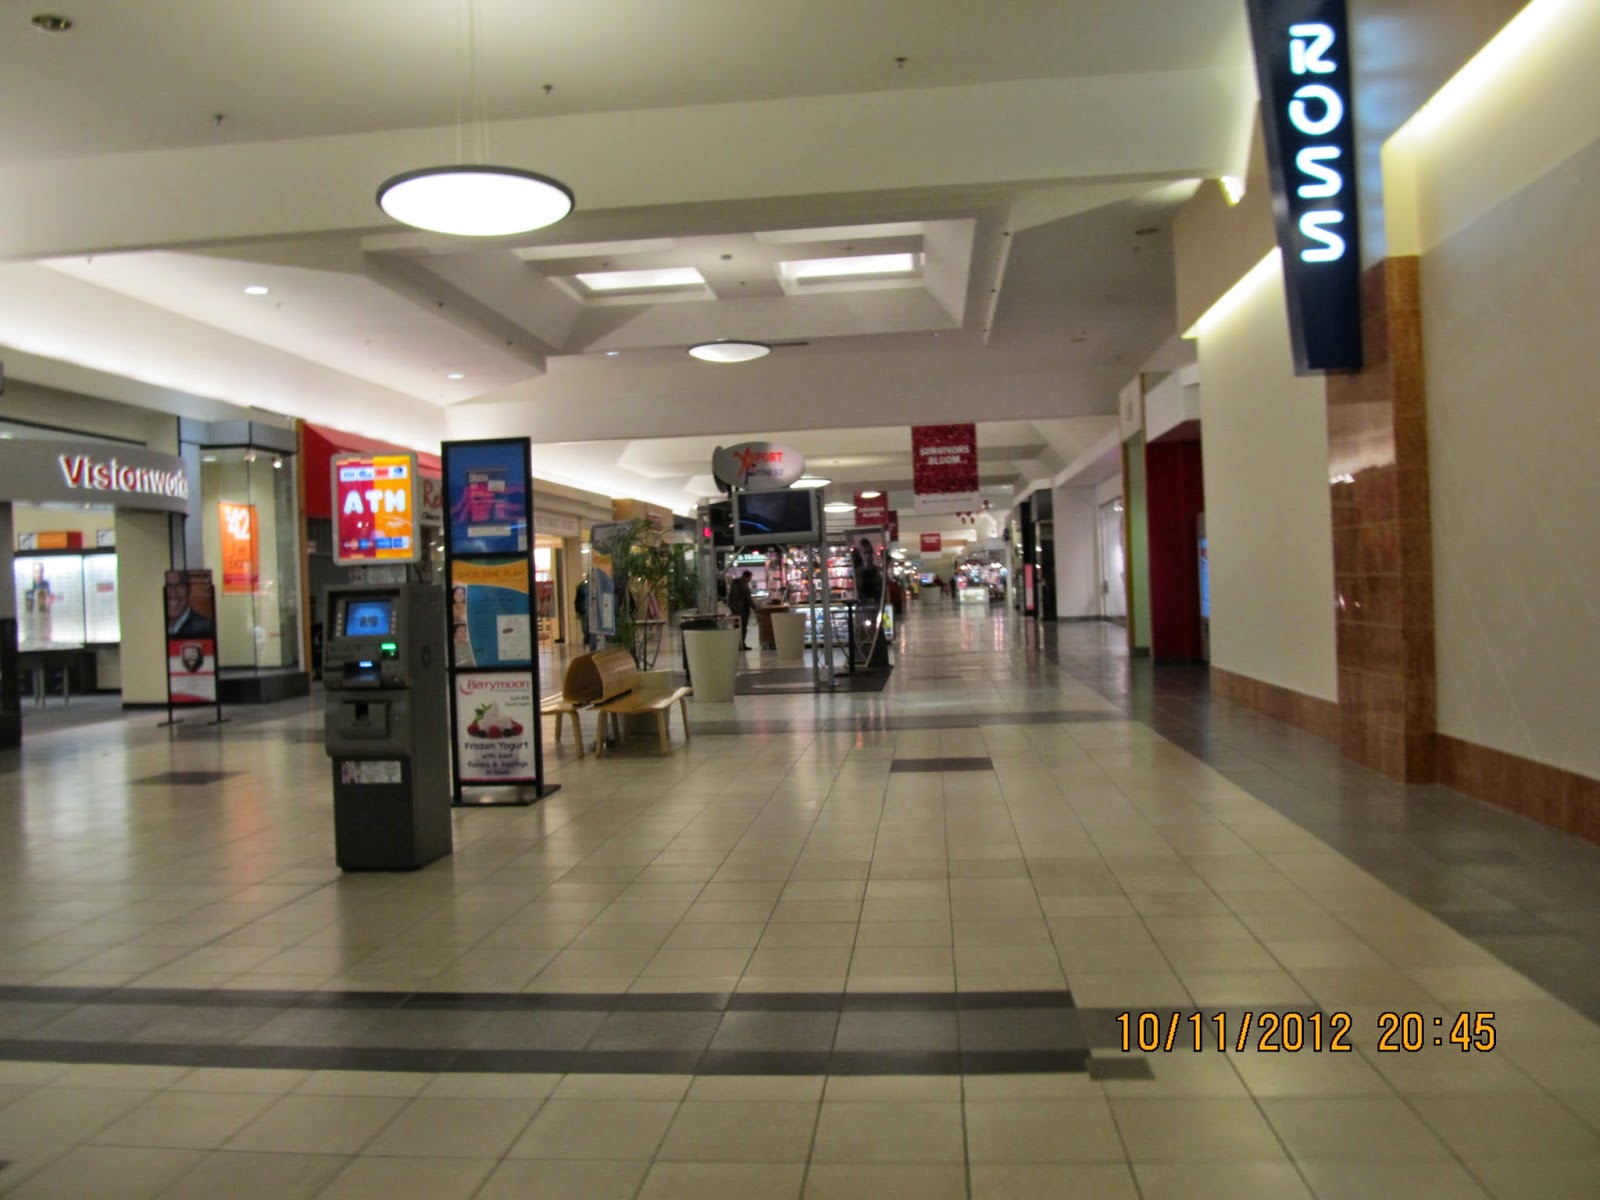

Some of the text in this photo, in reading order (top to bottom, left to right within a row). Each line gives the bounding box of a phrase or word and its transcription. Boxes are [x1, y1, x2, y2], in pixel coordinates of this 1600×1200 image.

[1288, 23, 1346, 263] ROSS
[344, 490, 406, 515] ATM
[467, 680, 529, 692] Berrymoon
[464, 740, 529, 752] Frozen Yogurt
